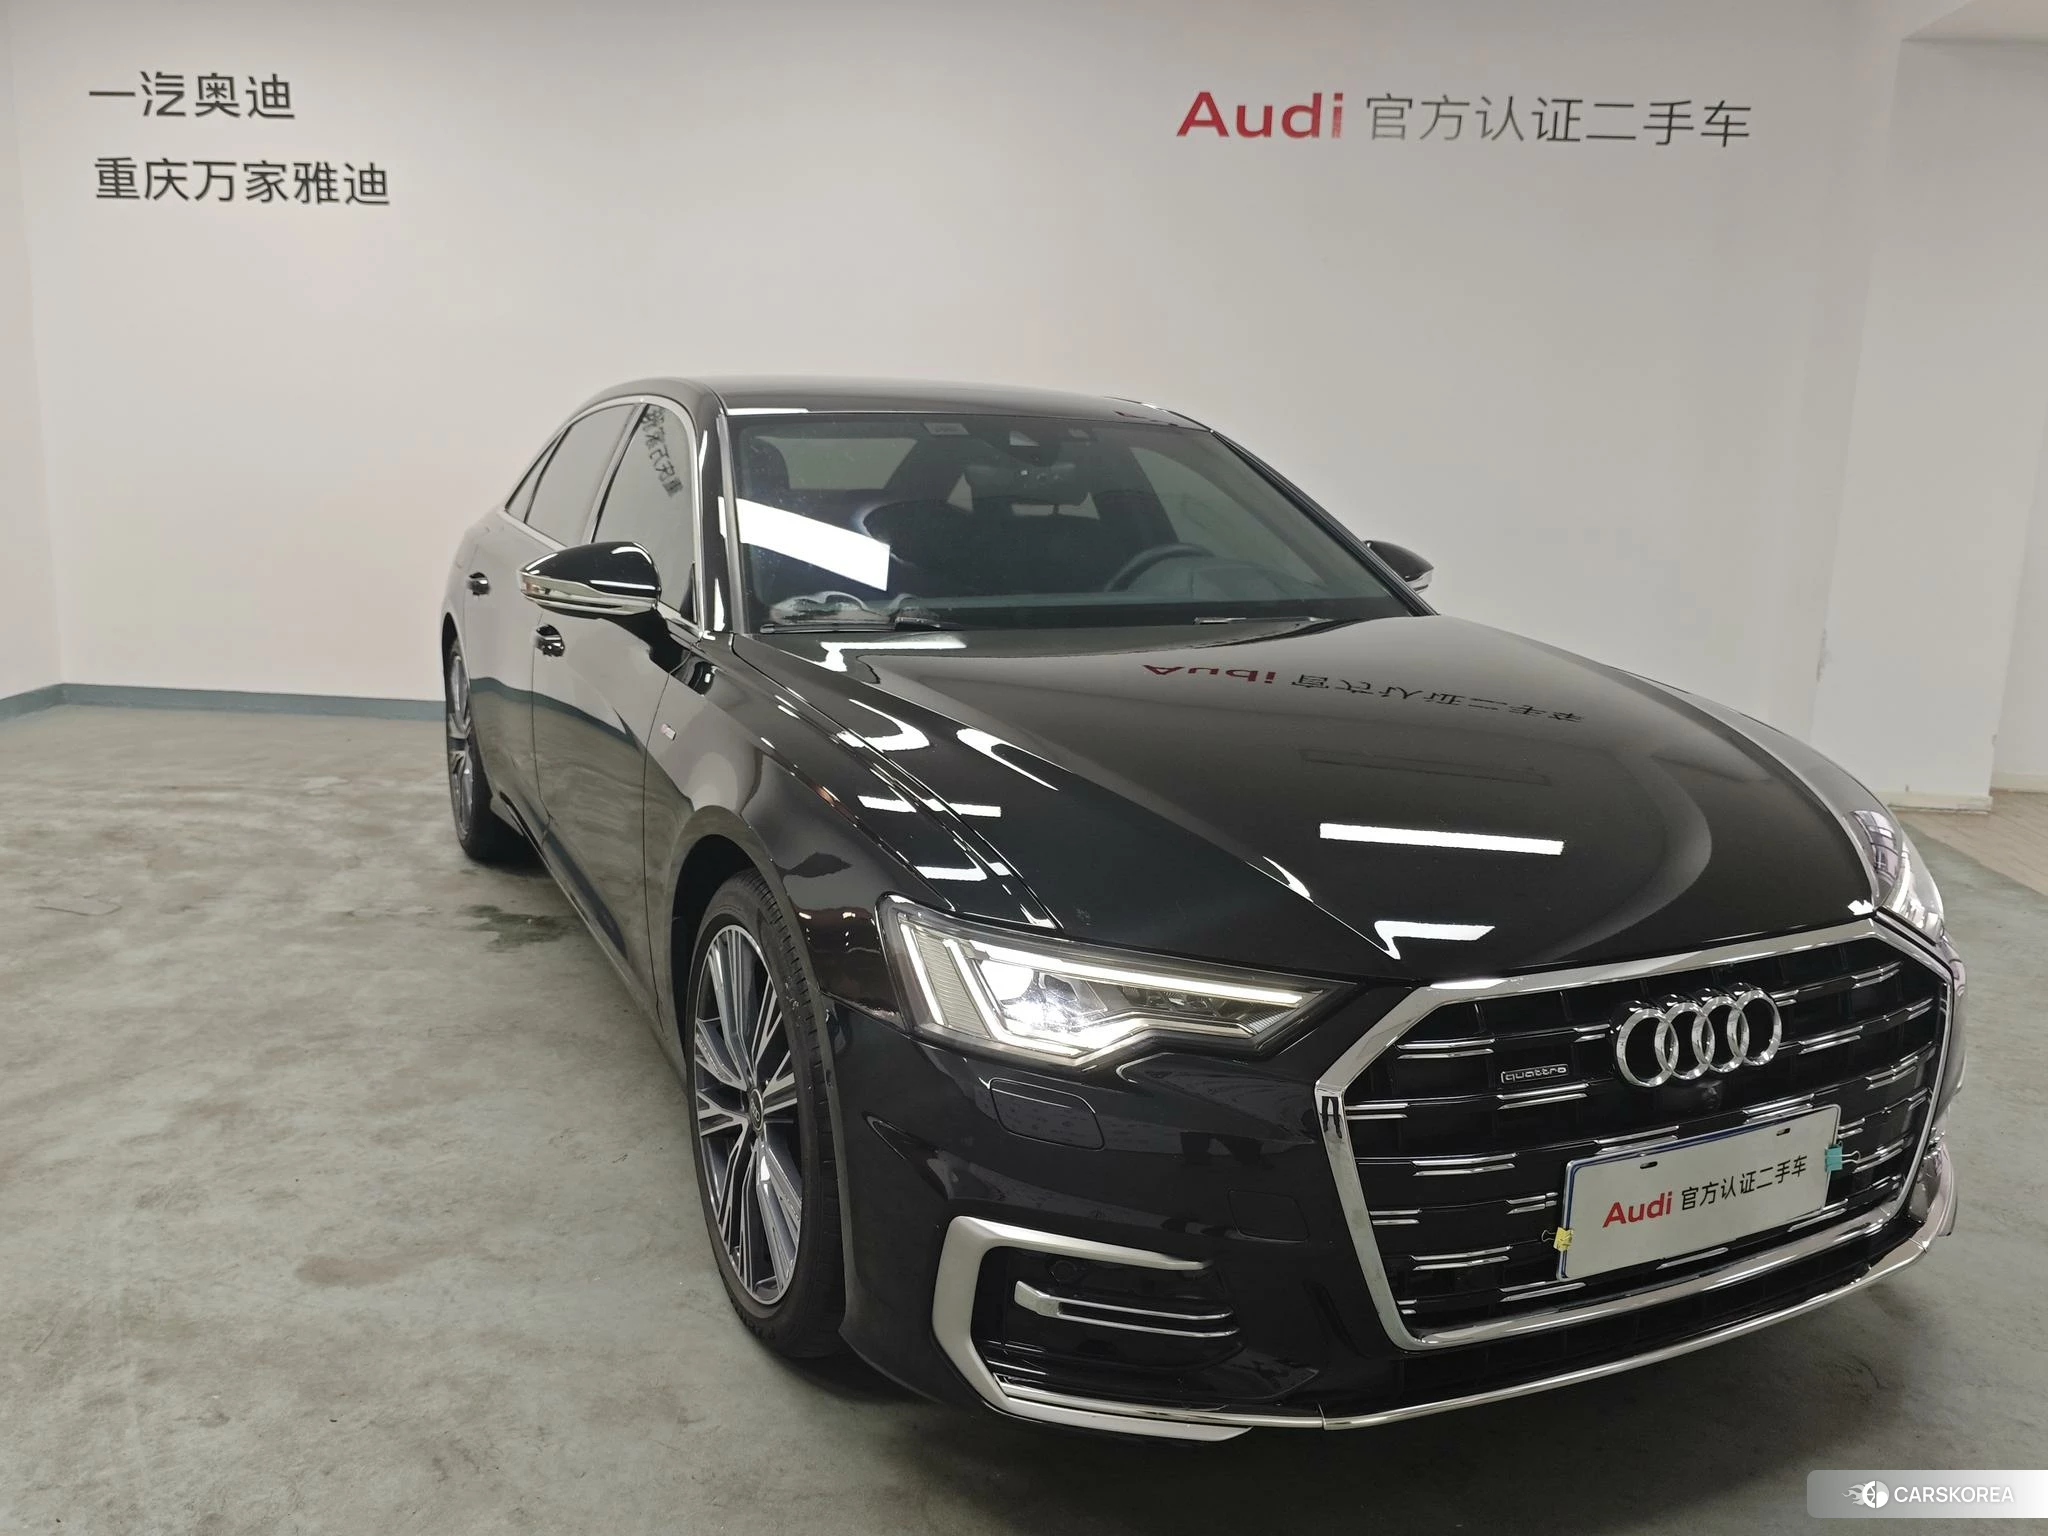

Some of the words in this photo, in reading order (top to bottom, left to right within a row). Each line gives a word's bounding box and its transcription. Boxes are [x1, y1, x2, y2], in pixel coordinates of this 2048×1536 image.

[89, 70, 295, 119] 一汽奥迪
[1177, 91, 1344, 138] Audi
[1366, 93, 1751, 147] 官方认证二手车
[95, 157, 390, 205] 重庆万家雅迪
[1505, 1067, 1567, 1082] quattro
[1602, 1191, 1673, 1228] Audi
[1681, 1155, 1808, 1211] 官方认证二手车
